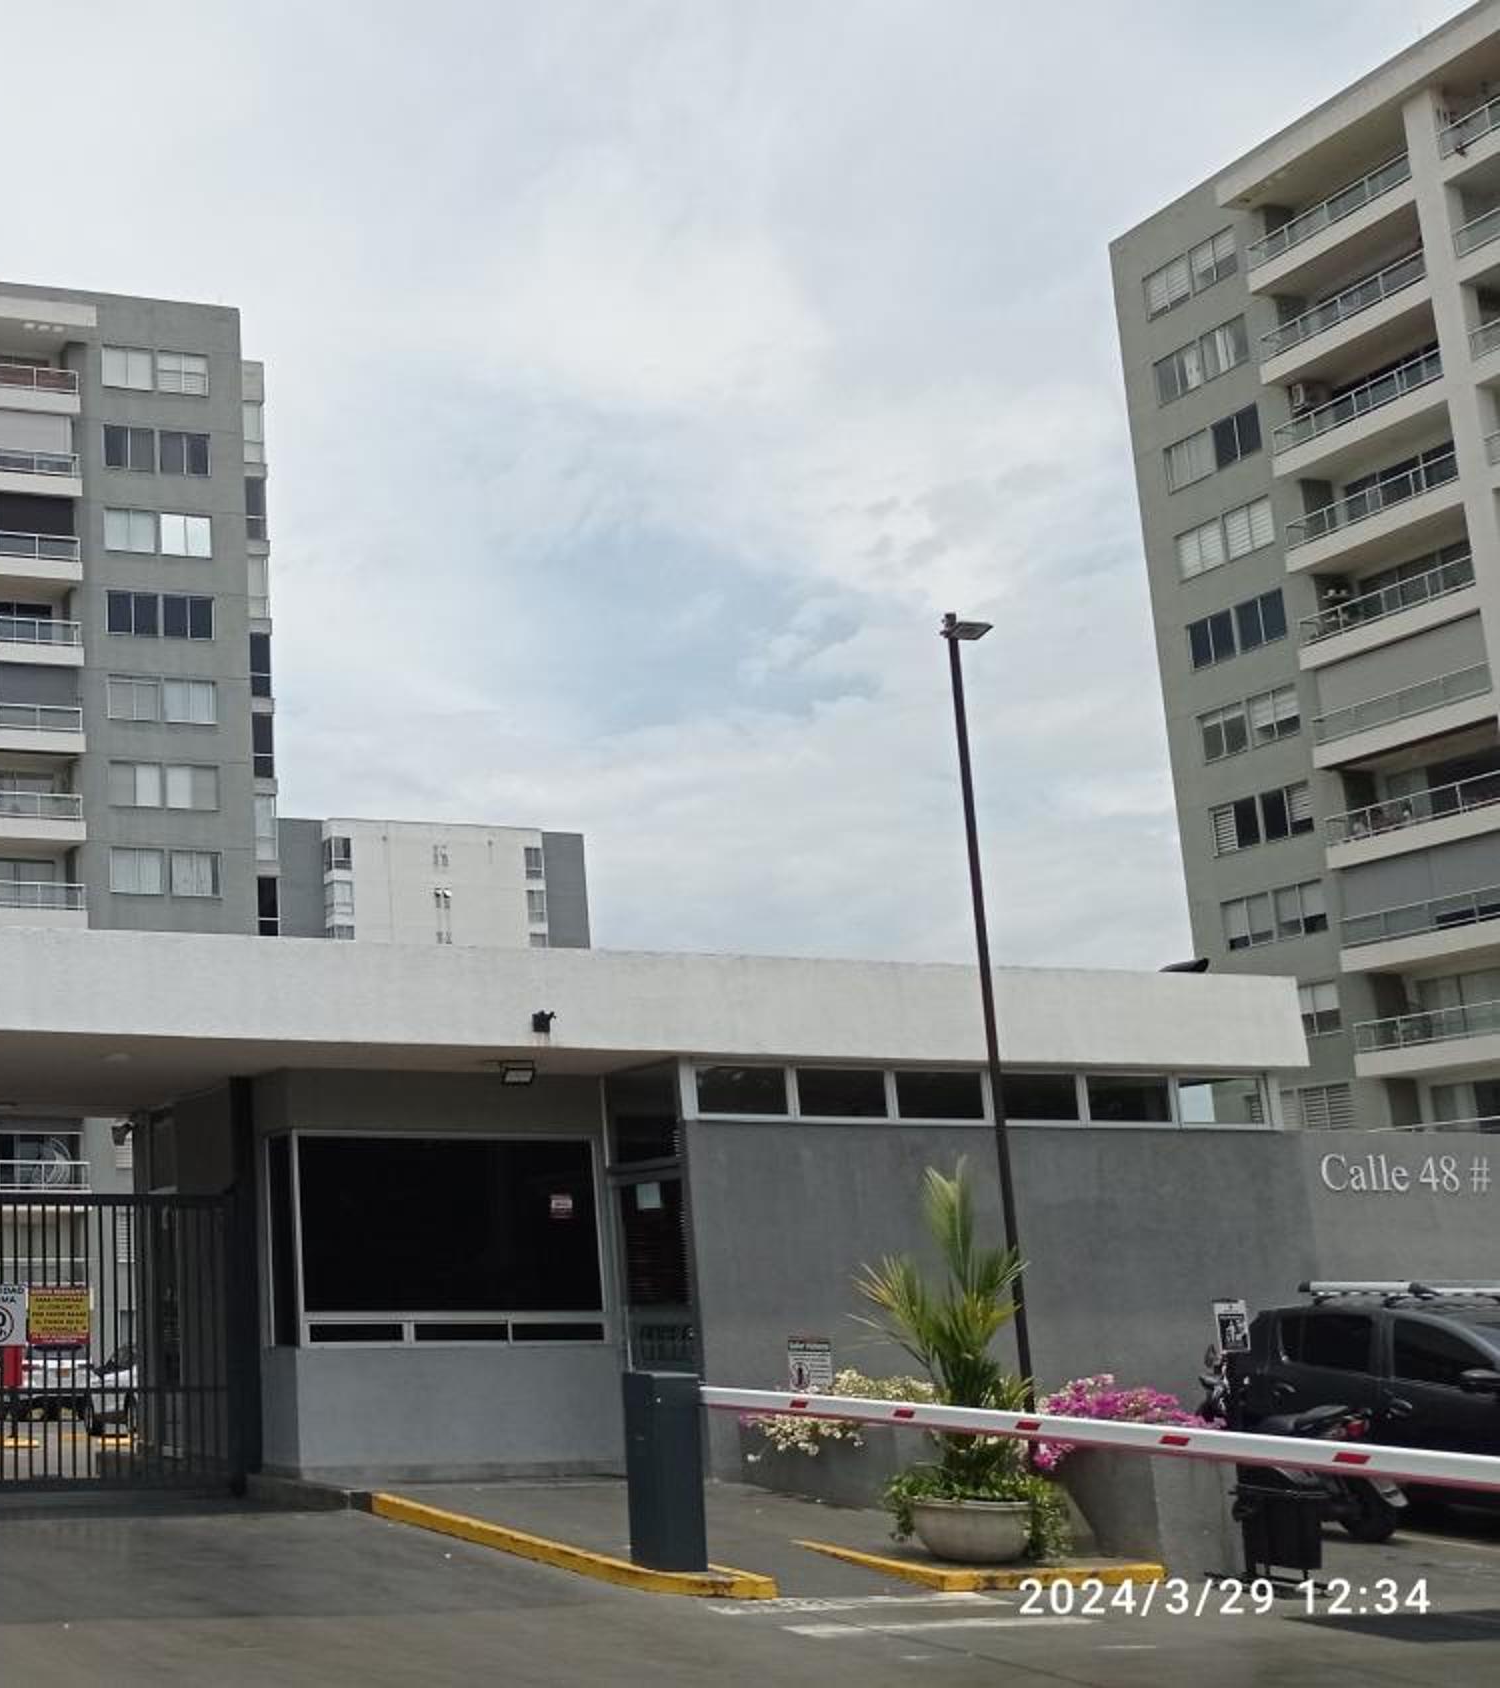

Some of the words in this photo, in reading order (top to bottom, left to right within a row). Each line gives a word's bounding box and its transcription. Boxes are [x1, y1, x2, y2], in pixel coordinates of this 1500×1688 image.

[1321, 1153, 1410, 1192] Calle
[1419, 1155, 1460, 1192] 48
[1469, 1156, 1491, 1192] #
